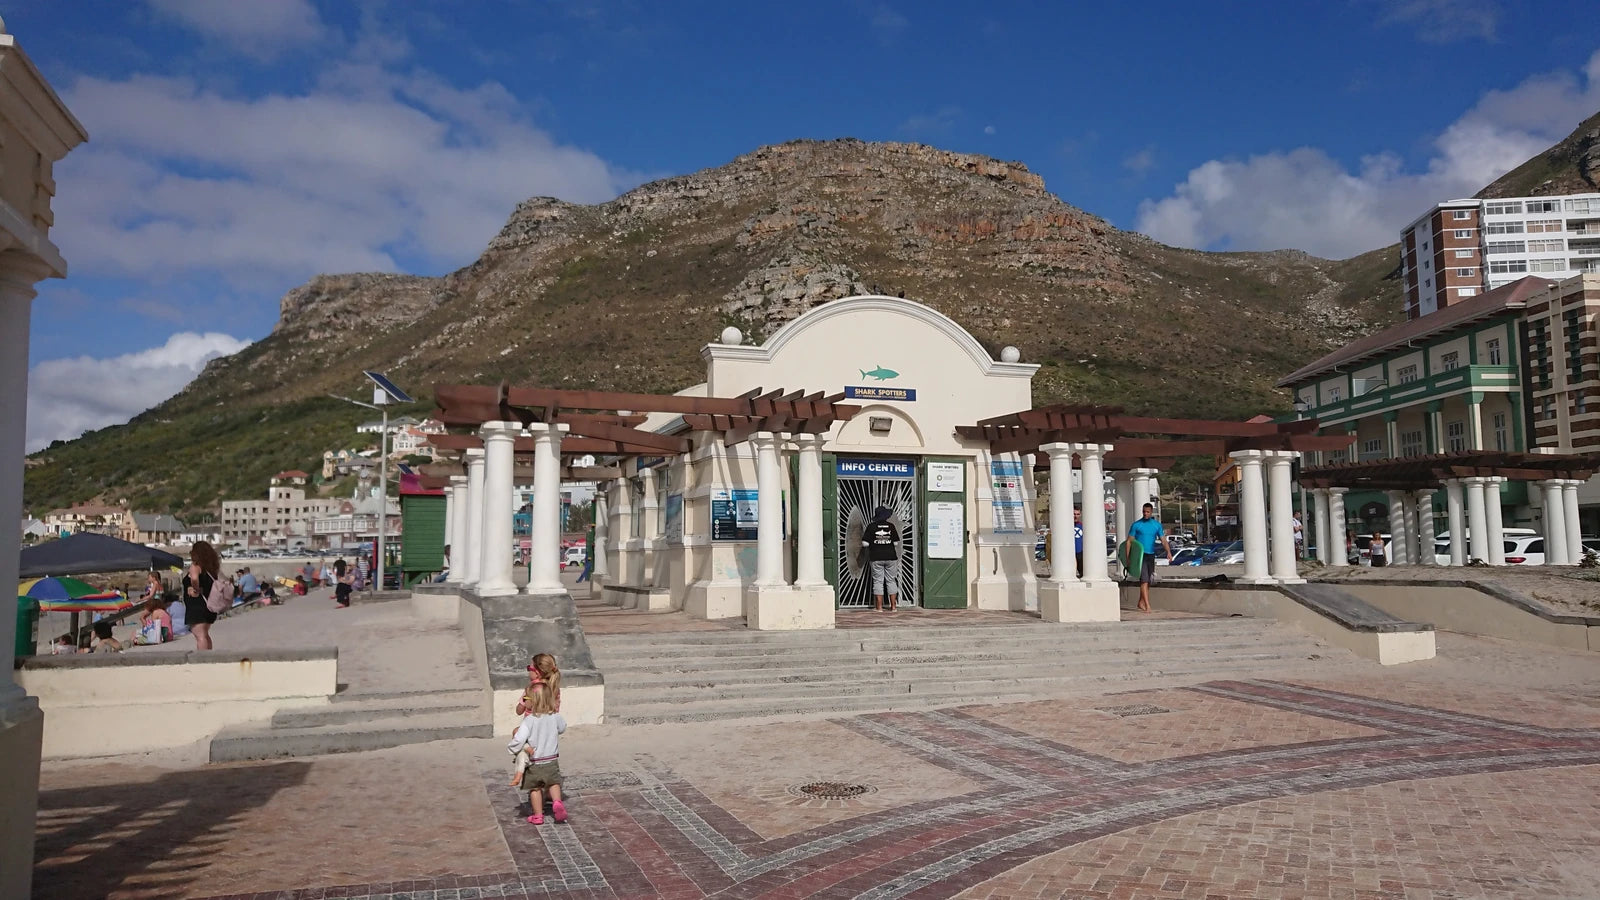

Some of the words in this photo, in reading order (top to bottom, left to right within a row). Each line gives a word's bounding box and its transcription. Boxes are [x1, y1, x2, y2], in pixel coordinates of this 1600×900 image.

[854, 388, 876, 396] SHARK
[878, 389, 907, 397] SPOTTERS
[841, 462, 866, 471] INFO
[868, 463, 908, 473] CENTRE
